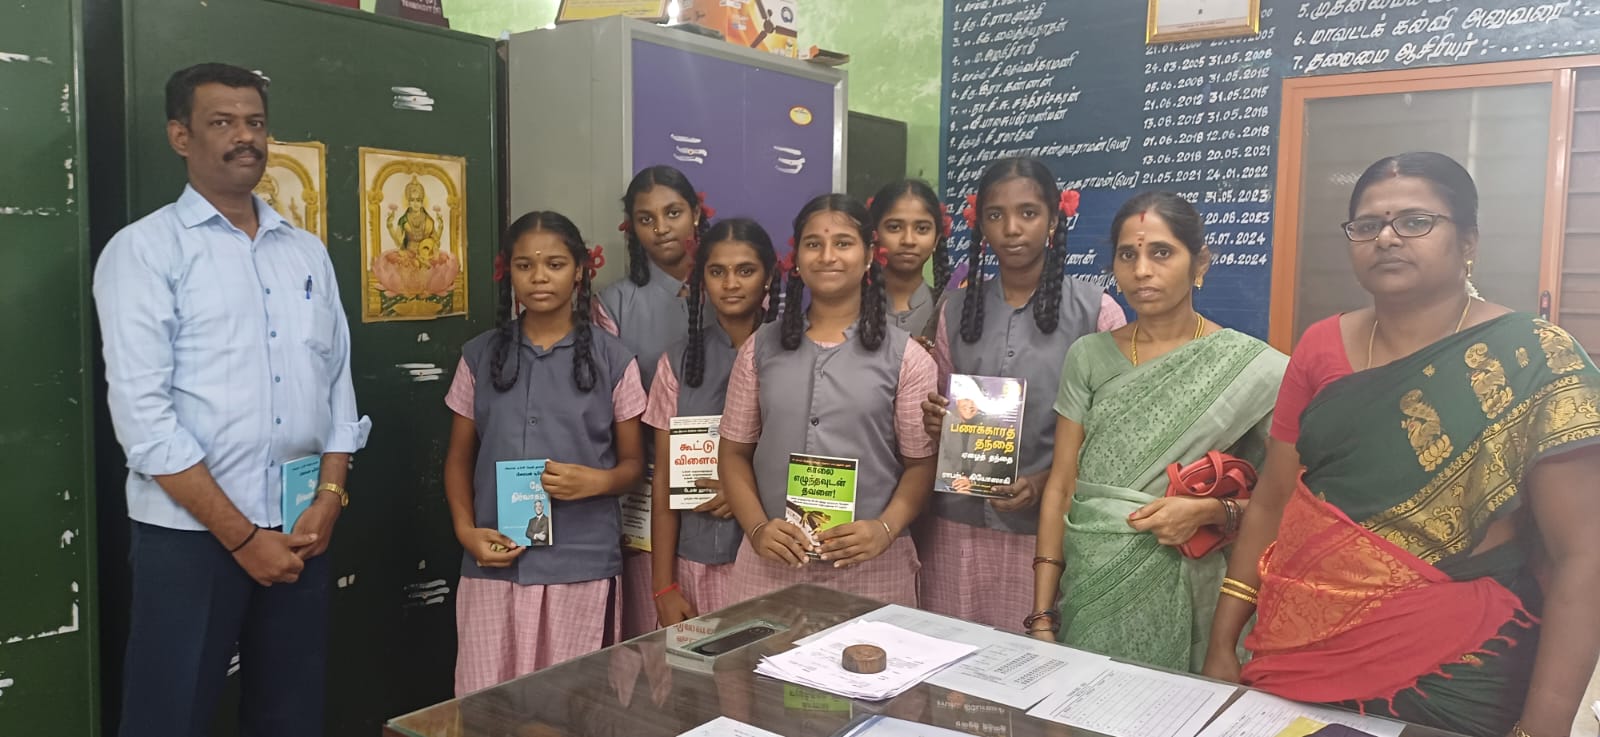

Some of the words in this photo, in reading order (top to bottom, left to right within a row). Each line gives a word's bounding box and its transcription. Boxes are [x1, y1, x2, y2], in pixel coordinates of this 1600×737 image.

[1392, 7, 1459, 36] கல்வி
[1144, 56, 1207, 74] 24.03.2005
[1208, 48, 1272, 66] 31.05.2008
[1208, 66, 1270, 83] 31.05.2012
[1143, 94, 1204, 111] 21.06.2012
[1208, 86, 1269, 103] 31.05.2015
[1143, 112, 1205, 129] 13.08.2015
[1207, 106, 1269, 123] 31.05.2018
[1143, 131, 1204, 147] 01.06.2018
[1206, 125, 1270, 141] 12.06.2018
[1142, 151, 1203, 165] 13.06.2018
[1206, 145, 1271, 161] 20.05.2021
[1141, 169, 1202, 184] 21.05.2021
[1205, 165, 1269, 180] 24.01.2022
[1204, 211, 1270, 225] 20.08.2023
[1204, 232, 1266, 245] 15.07.2024
[950, 422, 1016, 440] பணக்காரத்
[680, 439, 715, 453] கூட்டு
[974, 436, 1015, 453] தந்தை
[988, 453, 1013, 464] தந்தை
[806, 466, 835, 475] காலை
[793, 475, 847, 489] எழுந்தவுடன்
